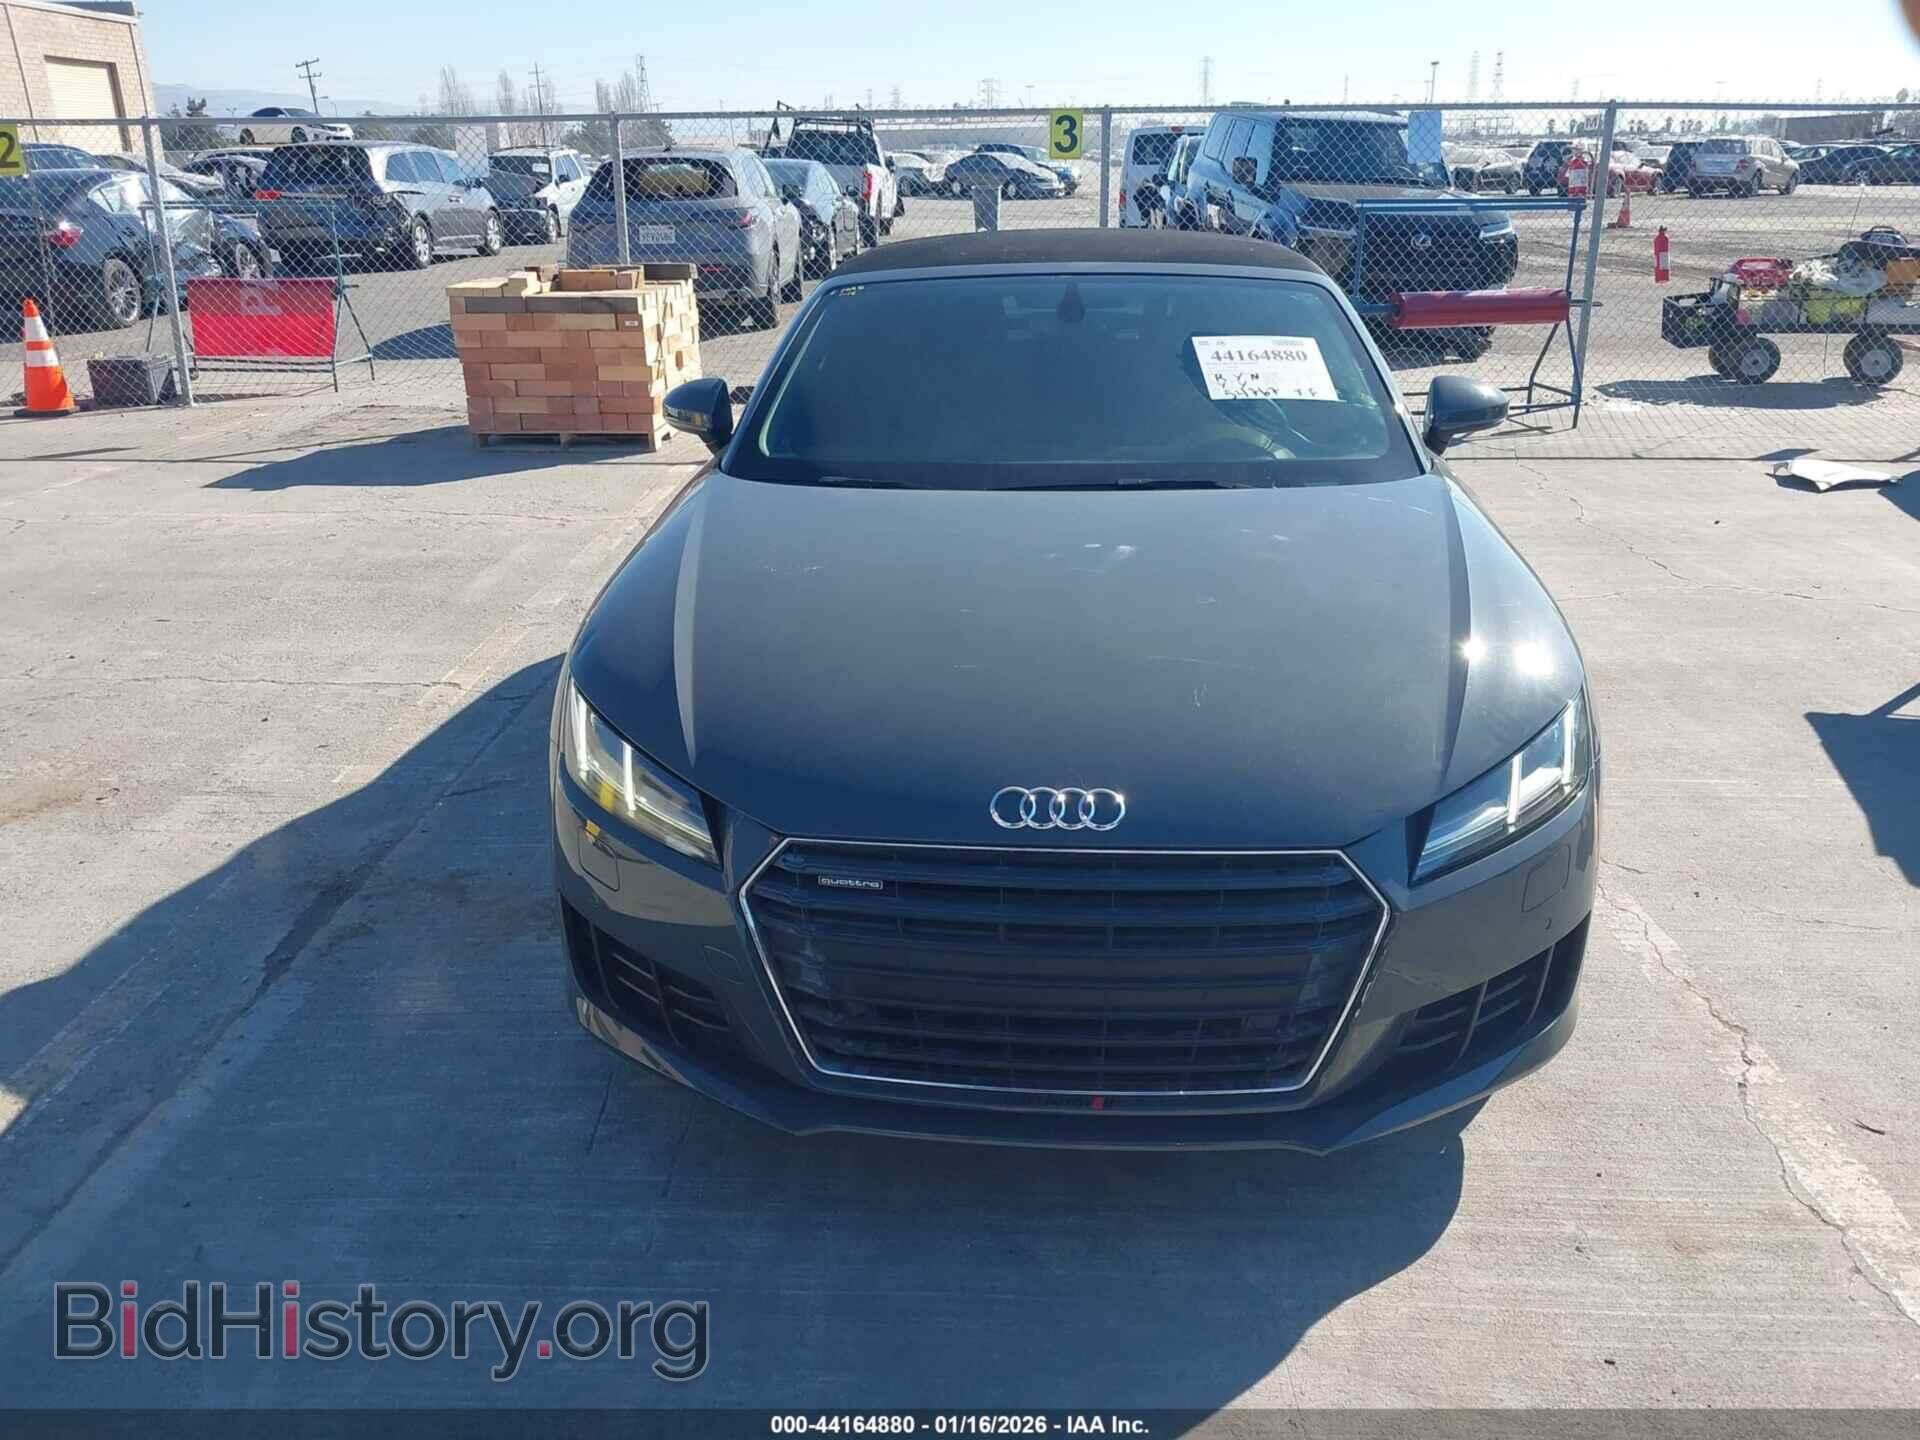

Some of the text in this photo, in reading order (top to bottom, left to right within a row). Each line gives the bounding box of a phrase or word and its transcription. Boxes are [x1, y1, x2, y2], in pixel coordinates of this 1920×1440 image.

[1054, 115, 1078, 153] 3
[0, 131, 20, 168] 2
[1211, 350, 1308, 362] 44164880
[821, 878, 880, 888] quattro
